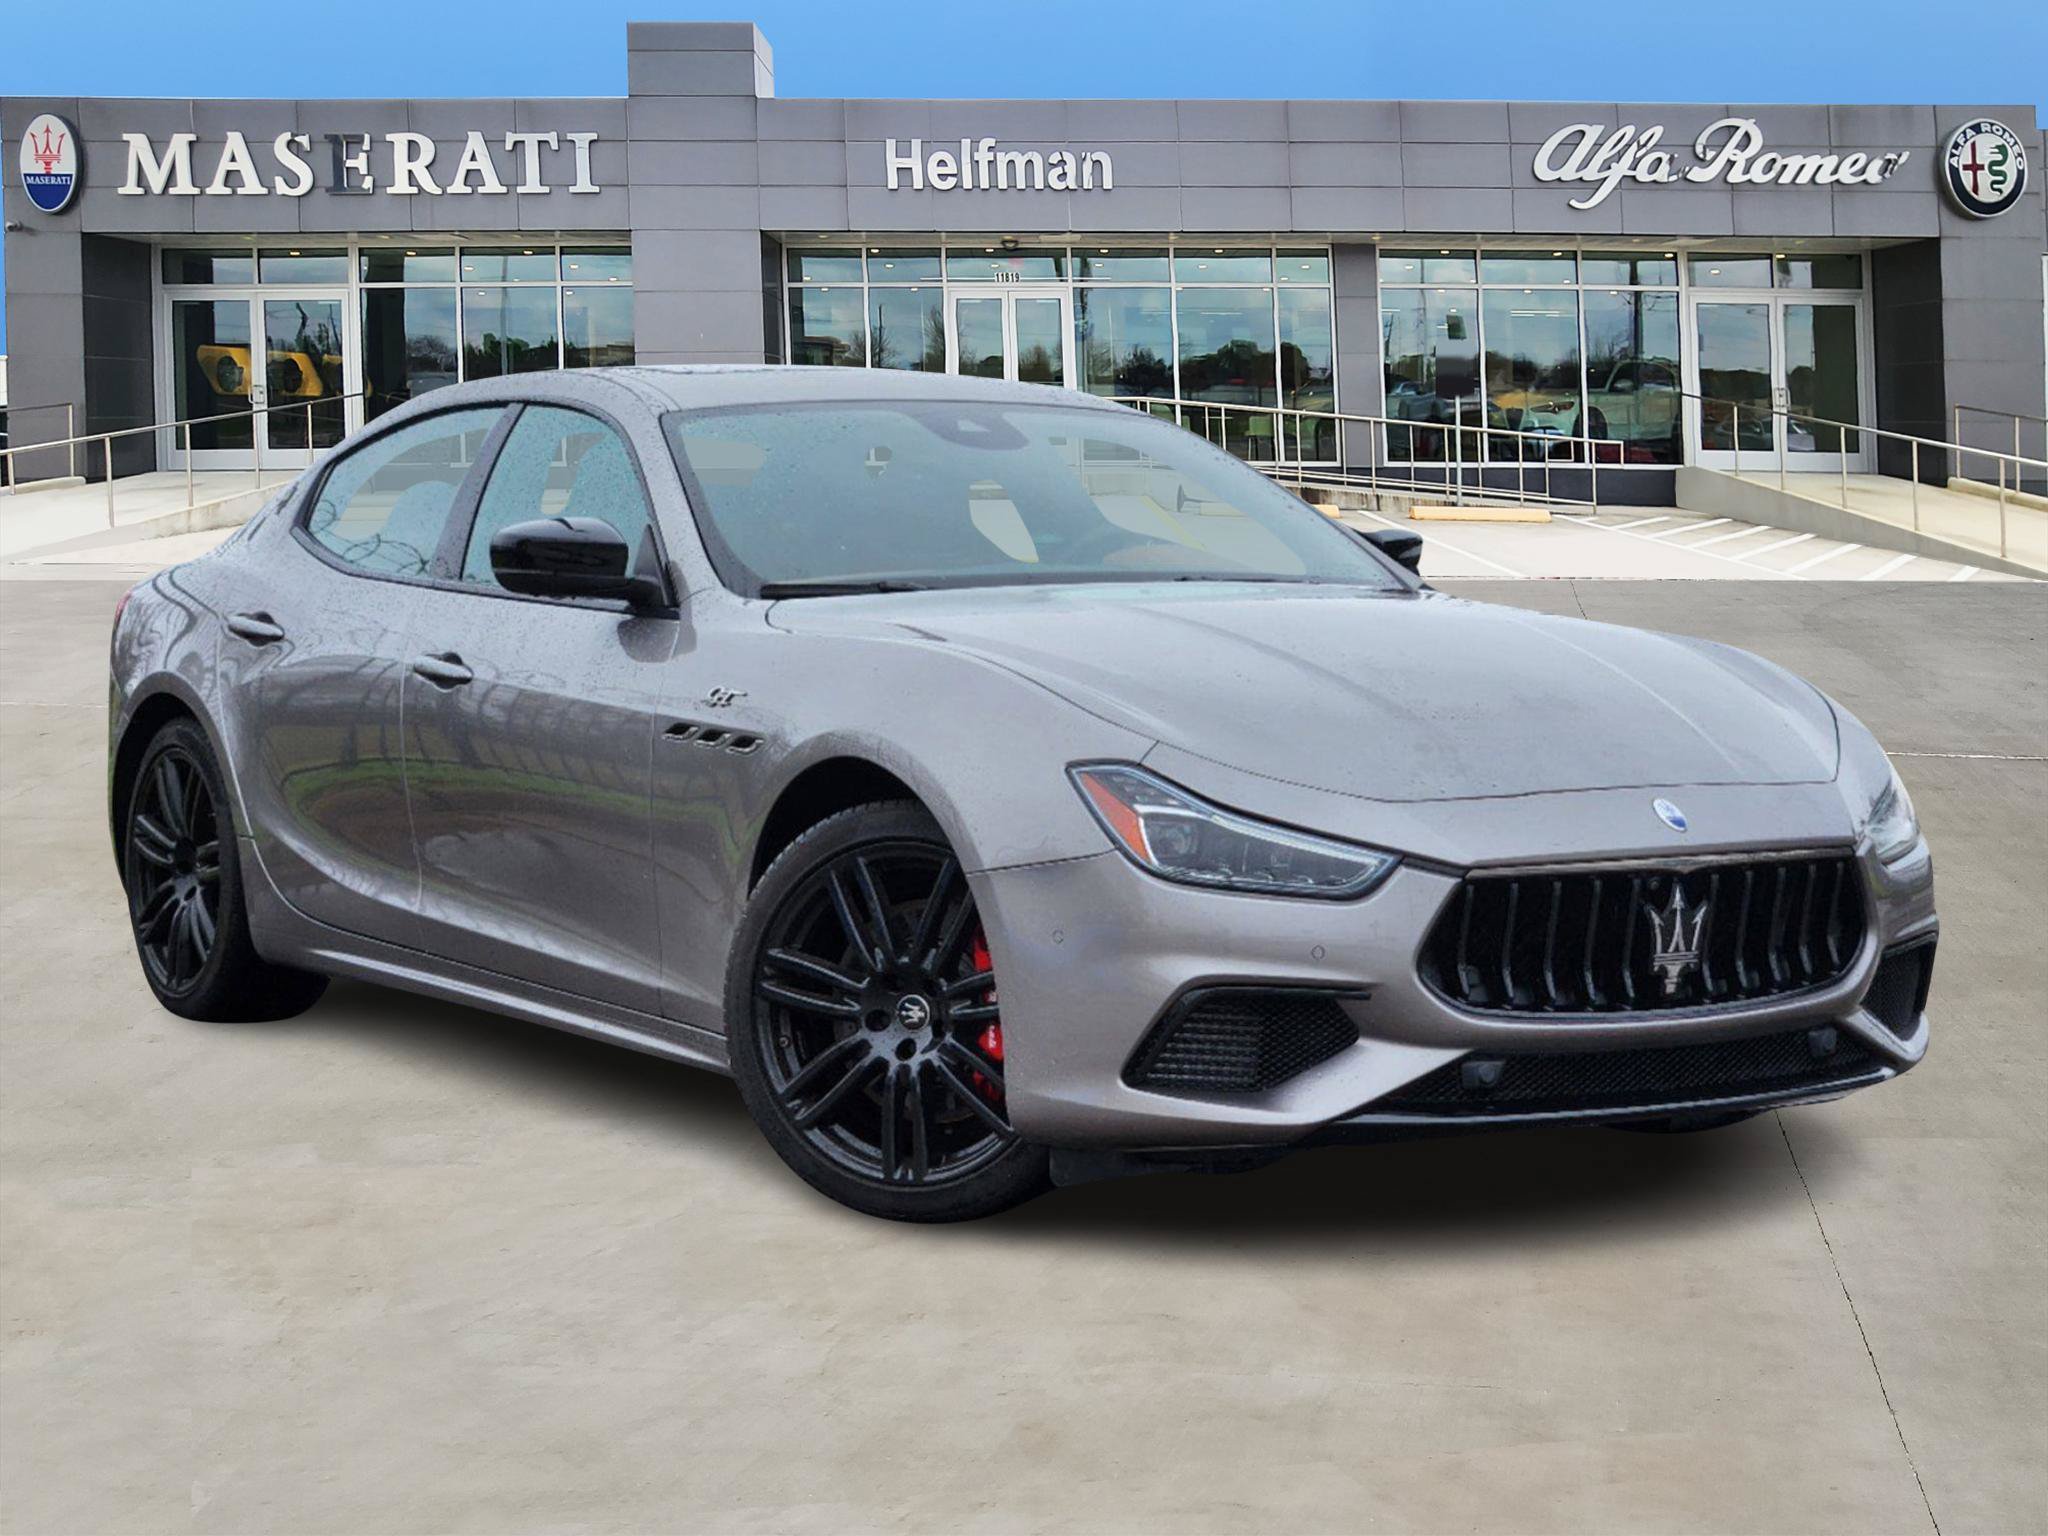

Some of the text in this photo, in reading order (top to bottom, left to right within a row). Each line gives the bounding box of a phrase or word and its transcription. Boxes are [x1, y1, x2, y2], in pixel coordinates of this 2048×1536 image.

[117, 131, 600, 196] MASERATI
[885, 137, 1113, 190] Helfman
[1533, 117, 1910, 209] Alfa Romeo
[1949, 122, 2024, 170] ALFA ROMEO
[26, 175, 71, 185] MASERATI
[995, 272, 1020, 283] 11819
